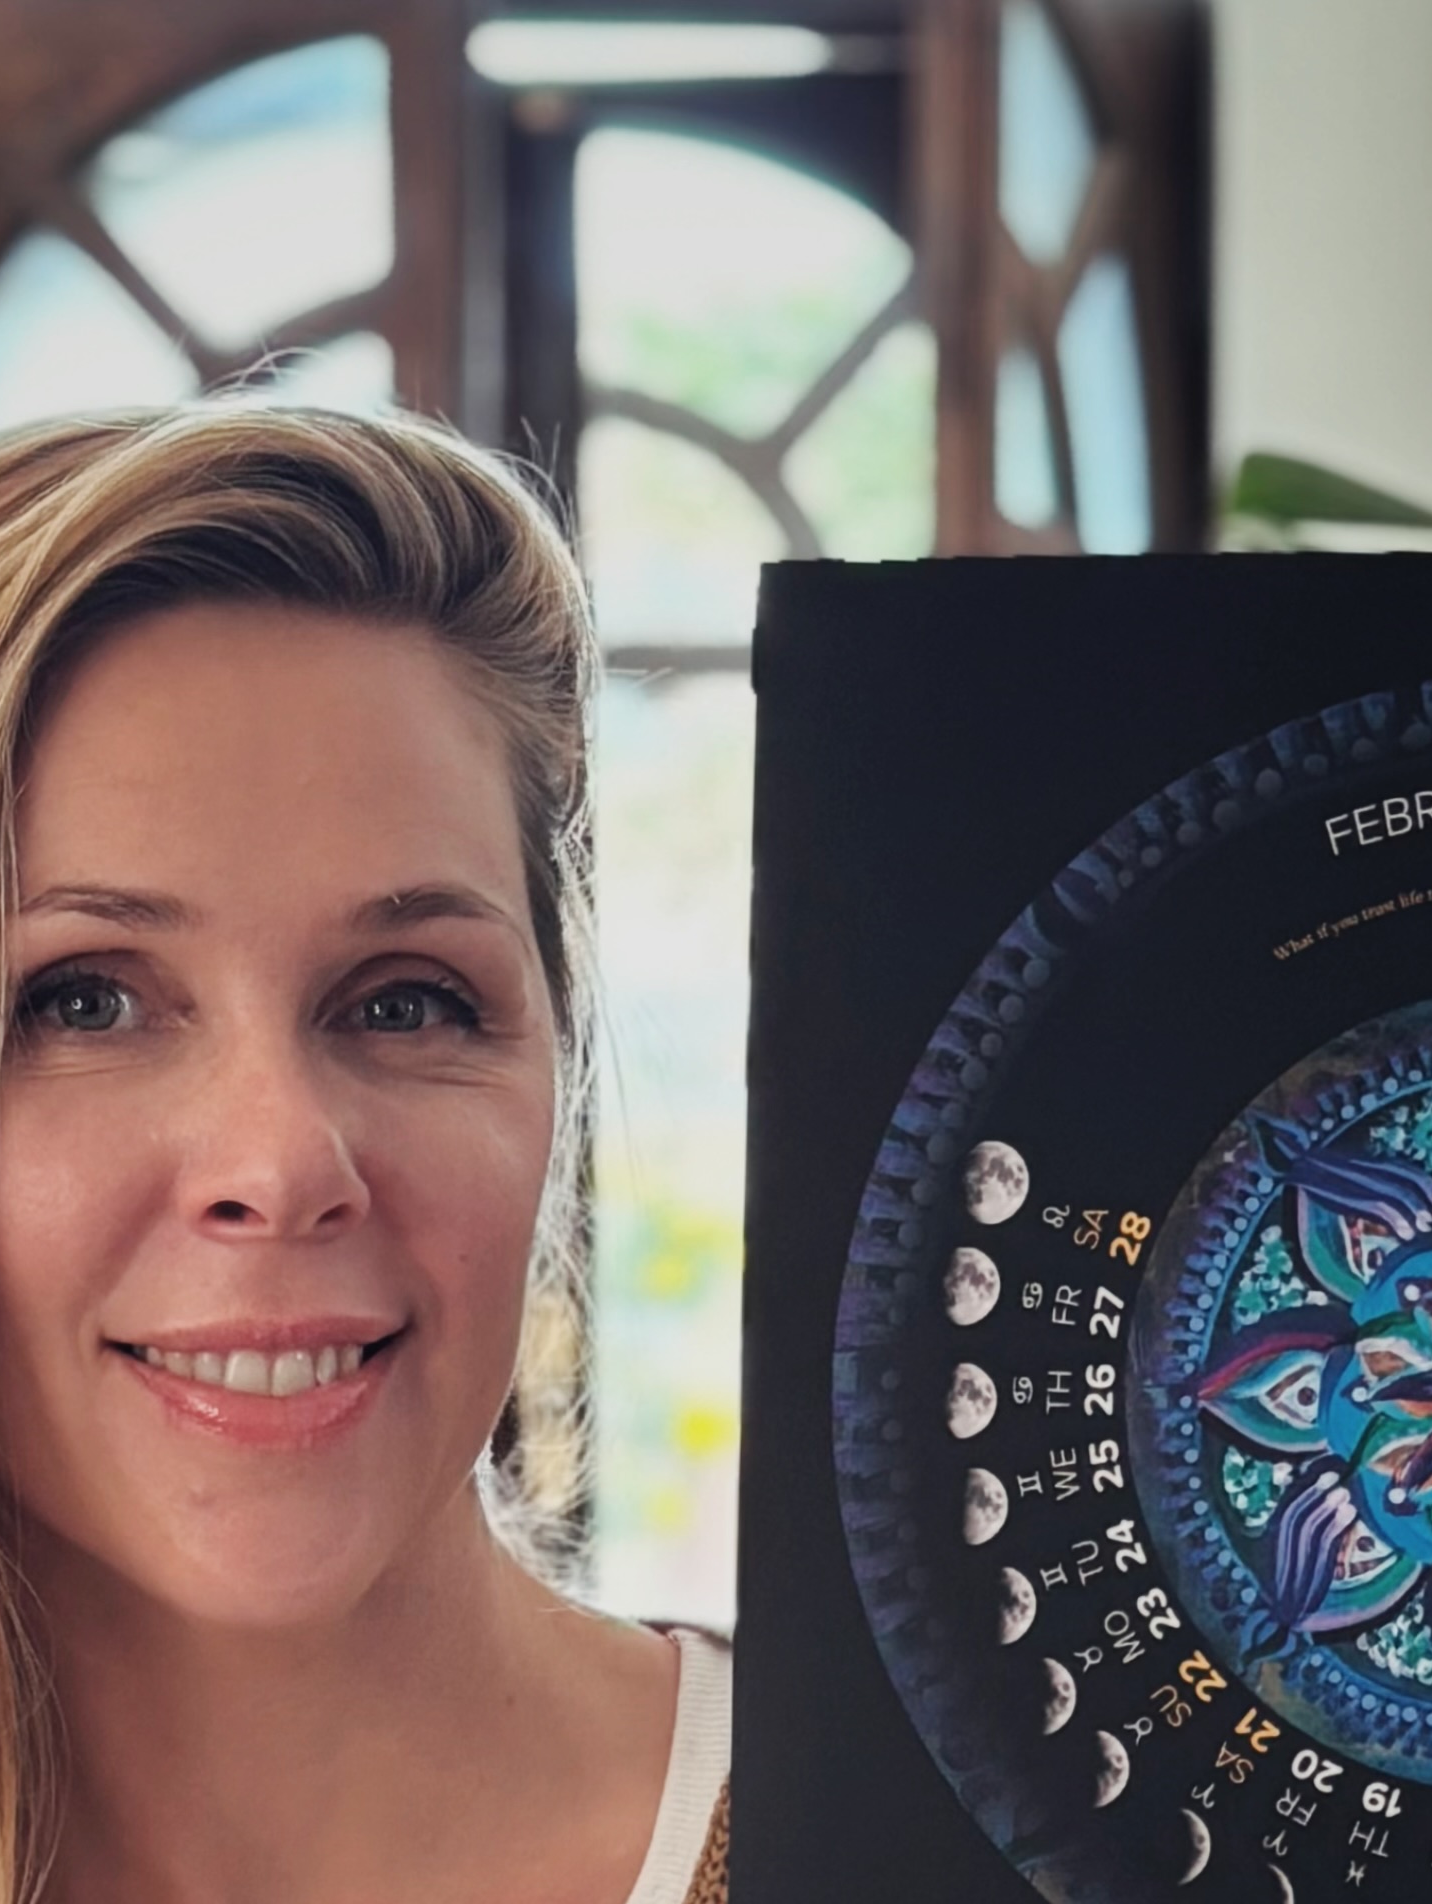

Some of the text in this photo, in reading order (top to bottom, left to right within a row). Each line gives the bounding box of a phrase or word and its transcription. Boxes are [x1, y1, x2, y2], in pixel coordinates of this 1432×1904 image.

[1274, 934, 1314, 959] What
[1074, 1210, 1109, 1249] SA
[1110, 1211, 1151, 1265] 28
[1052, 1285, 1081, 1325] FR
[1089, 1286, 1124, 1338] 27
[1046, 1371, 1072, 1413] TH
[1084, 1364, 1115, 1415] 26
[1050, 1448, 1080, 1500] WE
[1089, 1440, 1123, 1492] 25
[1072, 1540, 1103, 1585] TU
[1106, 1519, 1147, 1572] 24
[1104, 1607, 1148, 1663] MO
[1137, 1588, 1181, 1639] 23
[1179, 1650, 1227, 1702] 22
[1150, 1685, 1192, 1727] SU
[1235, 1704, 1284, 1752] 21
[1215, 1738, 1258, 1783] SA
[1292, 1749, 1343, 1793] 20
[1276, 1788, 1317, 1826] FR
[1363, 1782, 1401, 1817] 19
[1349, 1821, 1388, 1857] TH
